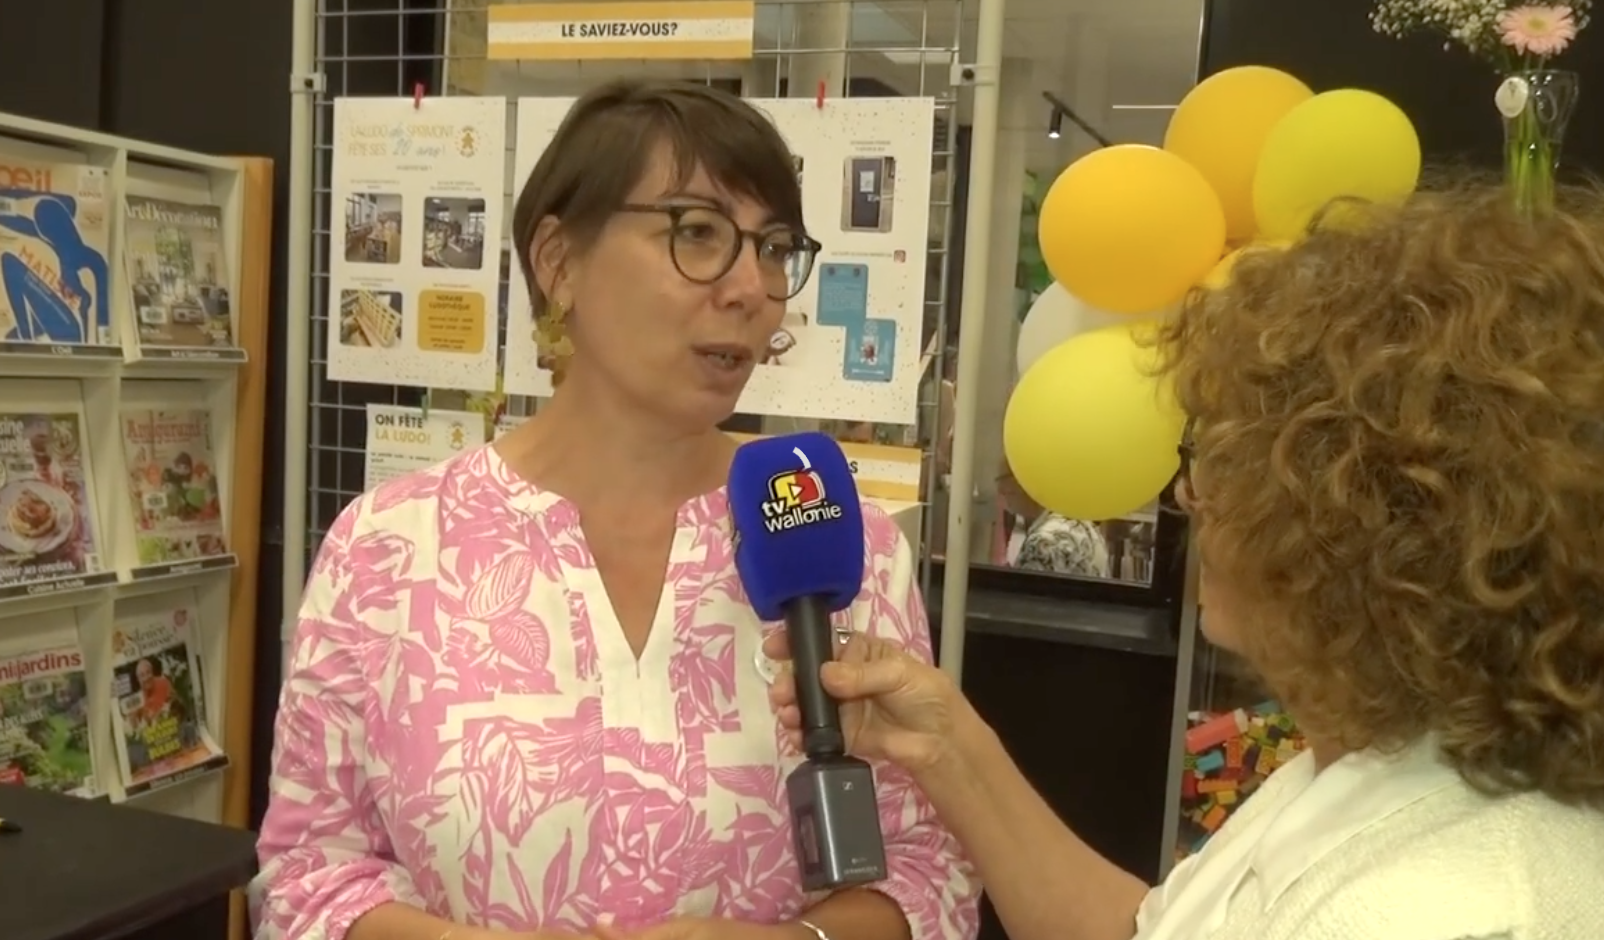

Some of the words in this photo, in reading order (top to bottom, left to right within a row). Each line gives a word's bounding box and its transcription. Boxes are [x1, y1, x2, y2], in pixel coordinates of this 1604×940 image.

[561, 24, 575, 37] LE
[580, 22, 678, 37] SAVIEZ-VOUS?
[407, 124, 455, 139] SPRIMONT
[392, 137, 413, 156] 20
[375, 414, 394, 426] ON
[399, 414, 424, 429] FÊTE
[375, 428, 389, 441] LA
[393, 430, 431, 444] LUDO!
[765, 501, 842, 534] wallonie
[17, 652, 82, 679] jardins
